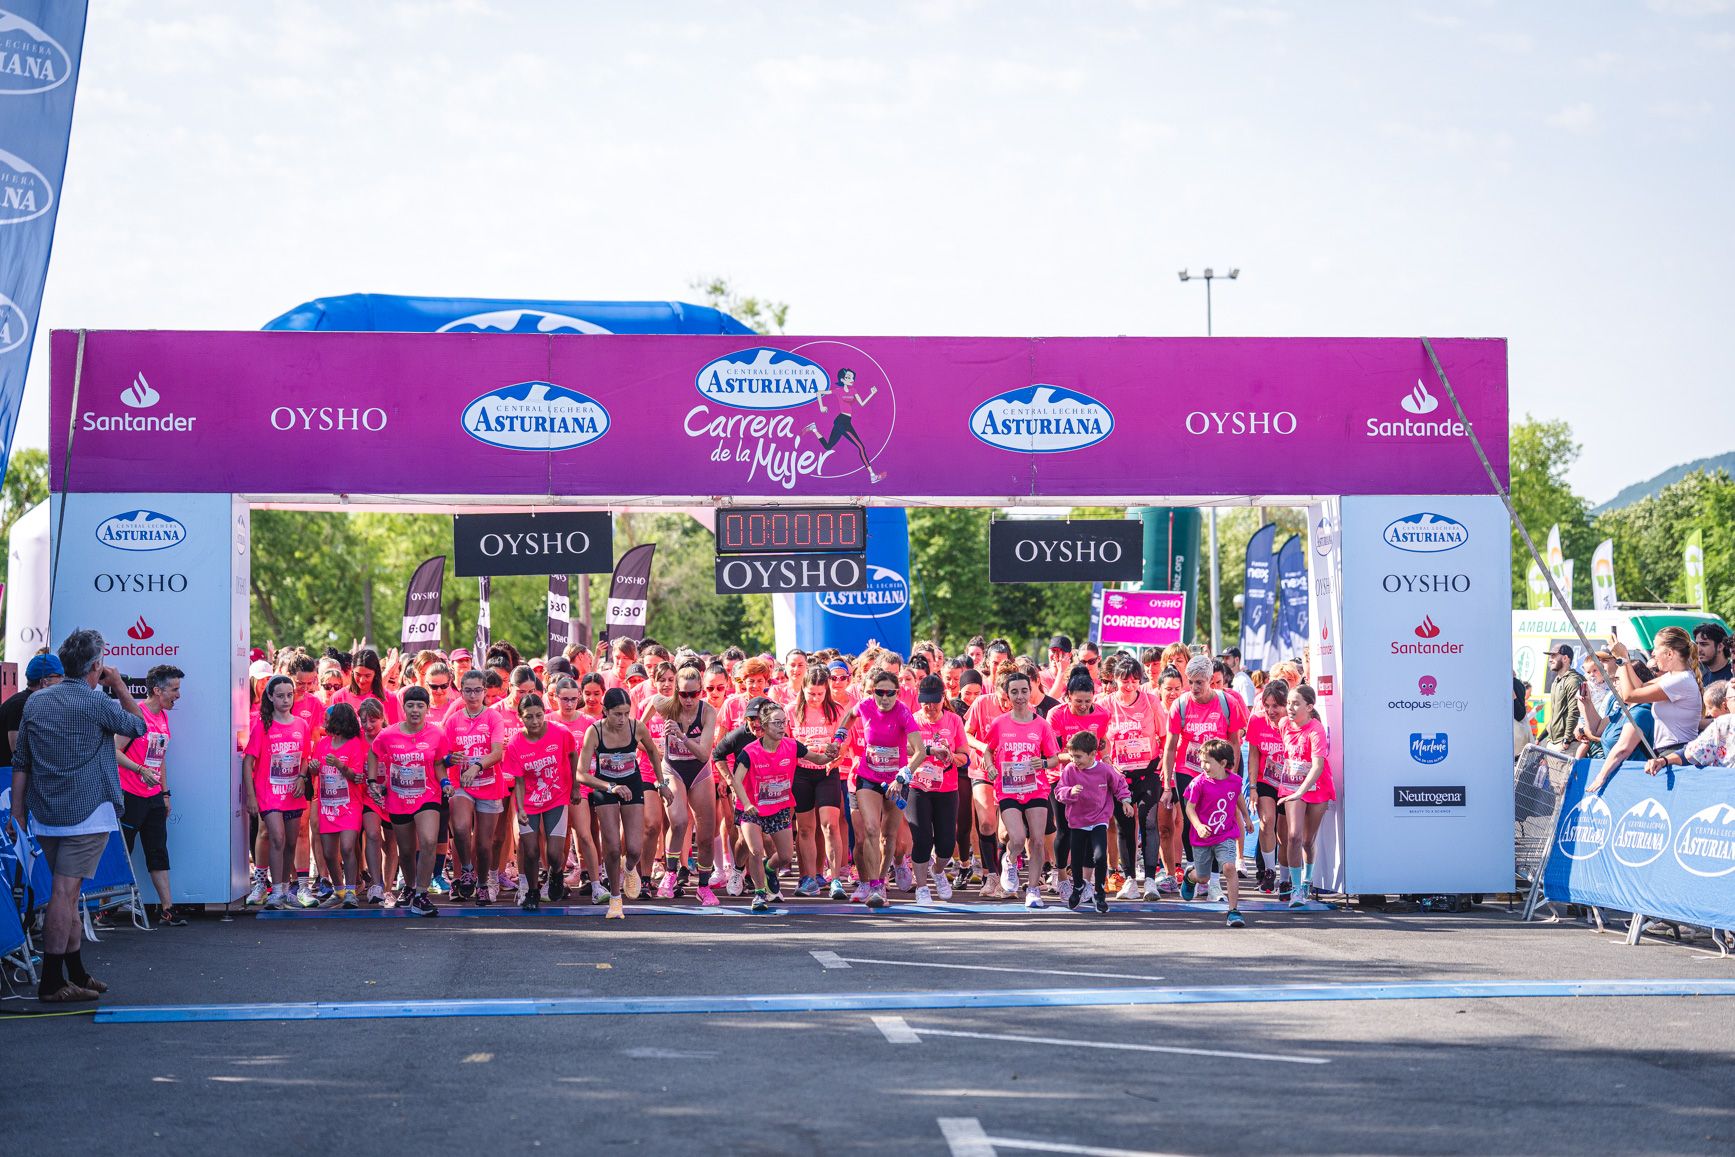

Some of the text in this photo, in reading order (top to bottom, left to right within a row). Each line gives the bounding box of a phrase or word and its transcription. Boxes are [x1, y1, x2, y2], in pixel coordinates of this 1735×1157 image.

[726, 368, 816, 376] CENTRAL LECHERA
[705, 374, 819, 395] ASTURIANA
[496, 404, 595, 414] CENTRAL LECHERA
[1002, 407, 1098, 415] CENTRAL LECHERA
[82, 411, 197, 432] Santander
[270, 406, 388, 432] OYSHO
[473, 409, 600, 435] ASTURIANA
[683, 404, 794, 439] Carrera
[980, 409, 1103, 436] ASTURIANA
[1184, 410, 1297, 436] OYSHO
[710, 431, 836, 490] de la Mujer
[102, 524, 180, 542] ASTURIANA
[1389, 525, 1463, 544] ASTURIANA
[479, 531, 591, 557] OYSHO
[1014, 540, 1123, 563] OYSHO
[616, 575, 646, 585] OYSHO
[722, 558, 860, 590] OYSHO
[93, 573, 188, 593] OYSHO
[1382, 574, 1471, 594] OYSHO
[411, 592, 439, 601] OYSHO
[823, 590, 905, 605] ASTURIANA
[1149, 599, 1182, 608] OYSHO
[1103, 614, 1181, 630] CORREDORAS
[102, 643, 179, 656] Santander
[1391, 642, 1464, 655] Santander
[1388, 700, 1468, 712] octopus energy
[797, 727, 828, 736] CARRERA
[1186, 722, 1218, 732] CARRERA
[271, 742, 300, 753] CARRERA
[456, 735, 487, 746] CARRERA
[1004, 742, 1036, 753] CARRERA
[1412, 740, 1446, 756] Marlene
[393, 753, 425, 763] CARRERA
[524, 755, 558, 771] CARRERA
[1398, 790, 1462, 805] Neutrogena
[1614, 822, 1664, 850] ASTURIANA
